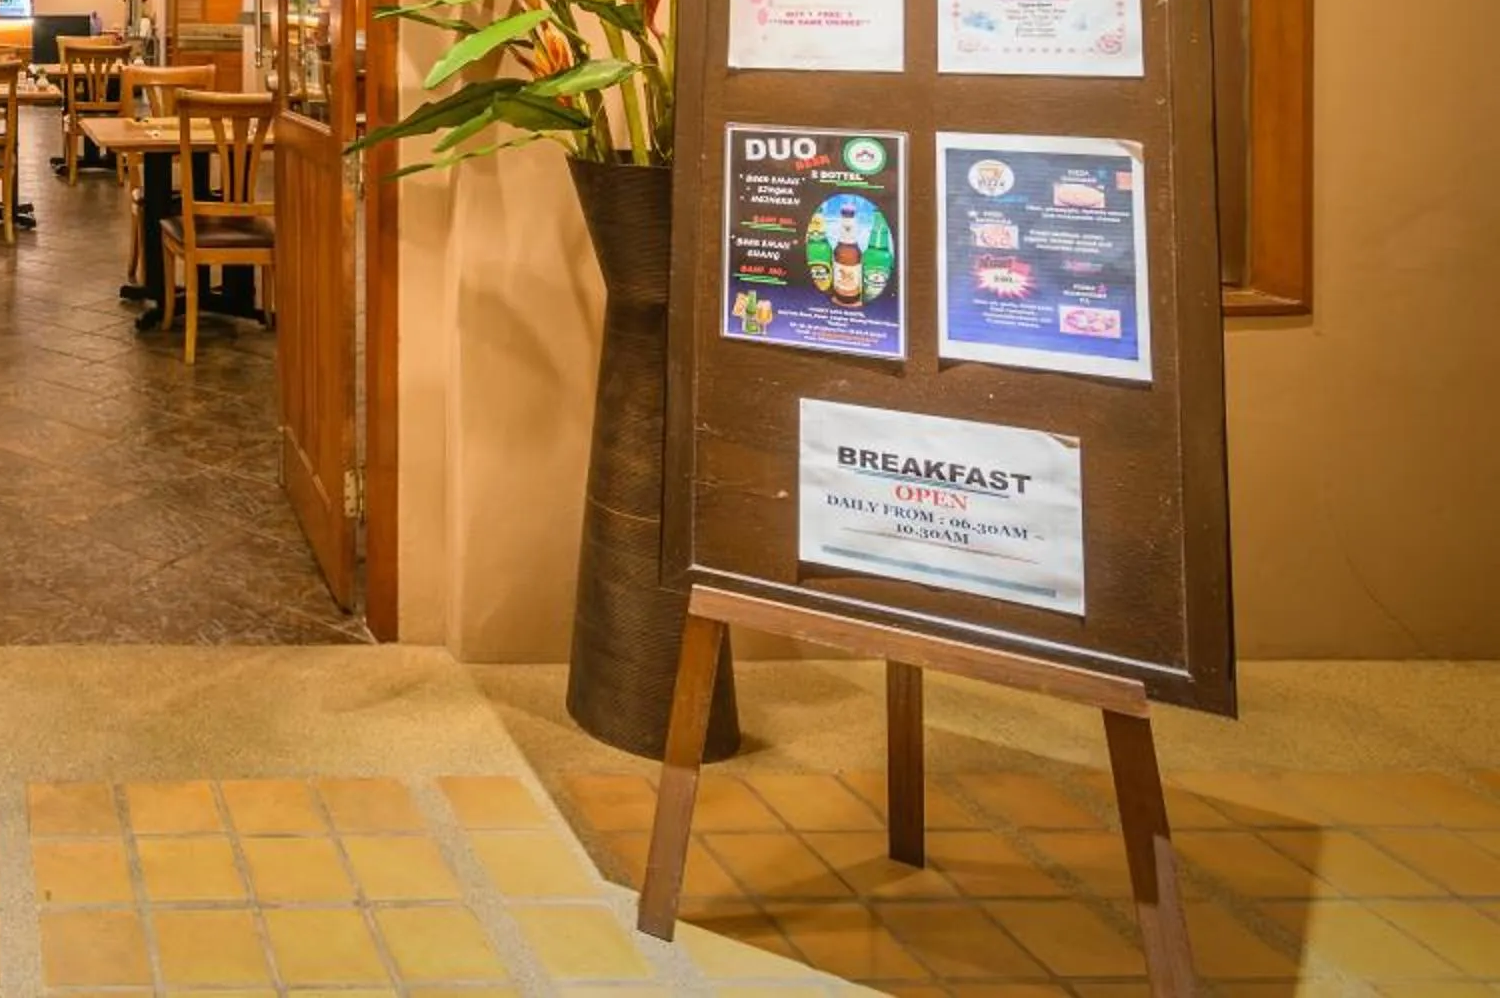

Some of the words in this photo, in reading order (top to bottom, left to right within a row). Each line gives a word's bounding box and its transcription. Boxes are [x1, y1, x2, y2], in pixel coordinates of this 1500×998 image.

[744, 137, 817, 161] DUO
[837, 445, 1032, 494] BREAKFAST
[894, 485, 968, 511] OPEN
[826, 494, 880, 514] DAILY
[883, 504, 934, 524] FROM
[949, 517, 1028, 541] 06.30AM
[896, 523, 970, 545] 10.30AM
